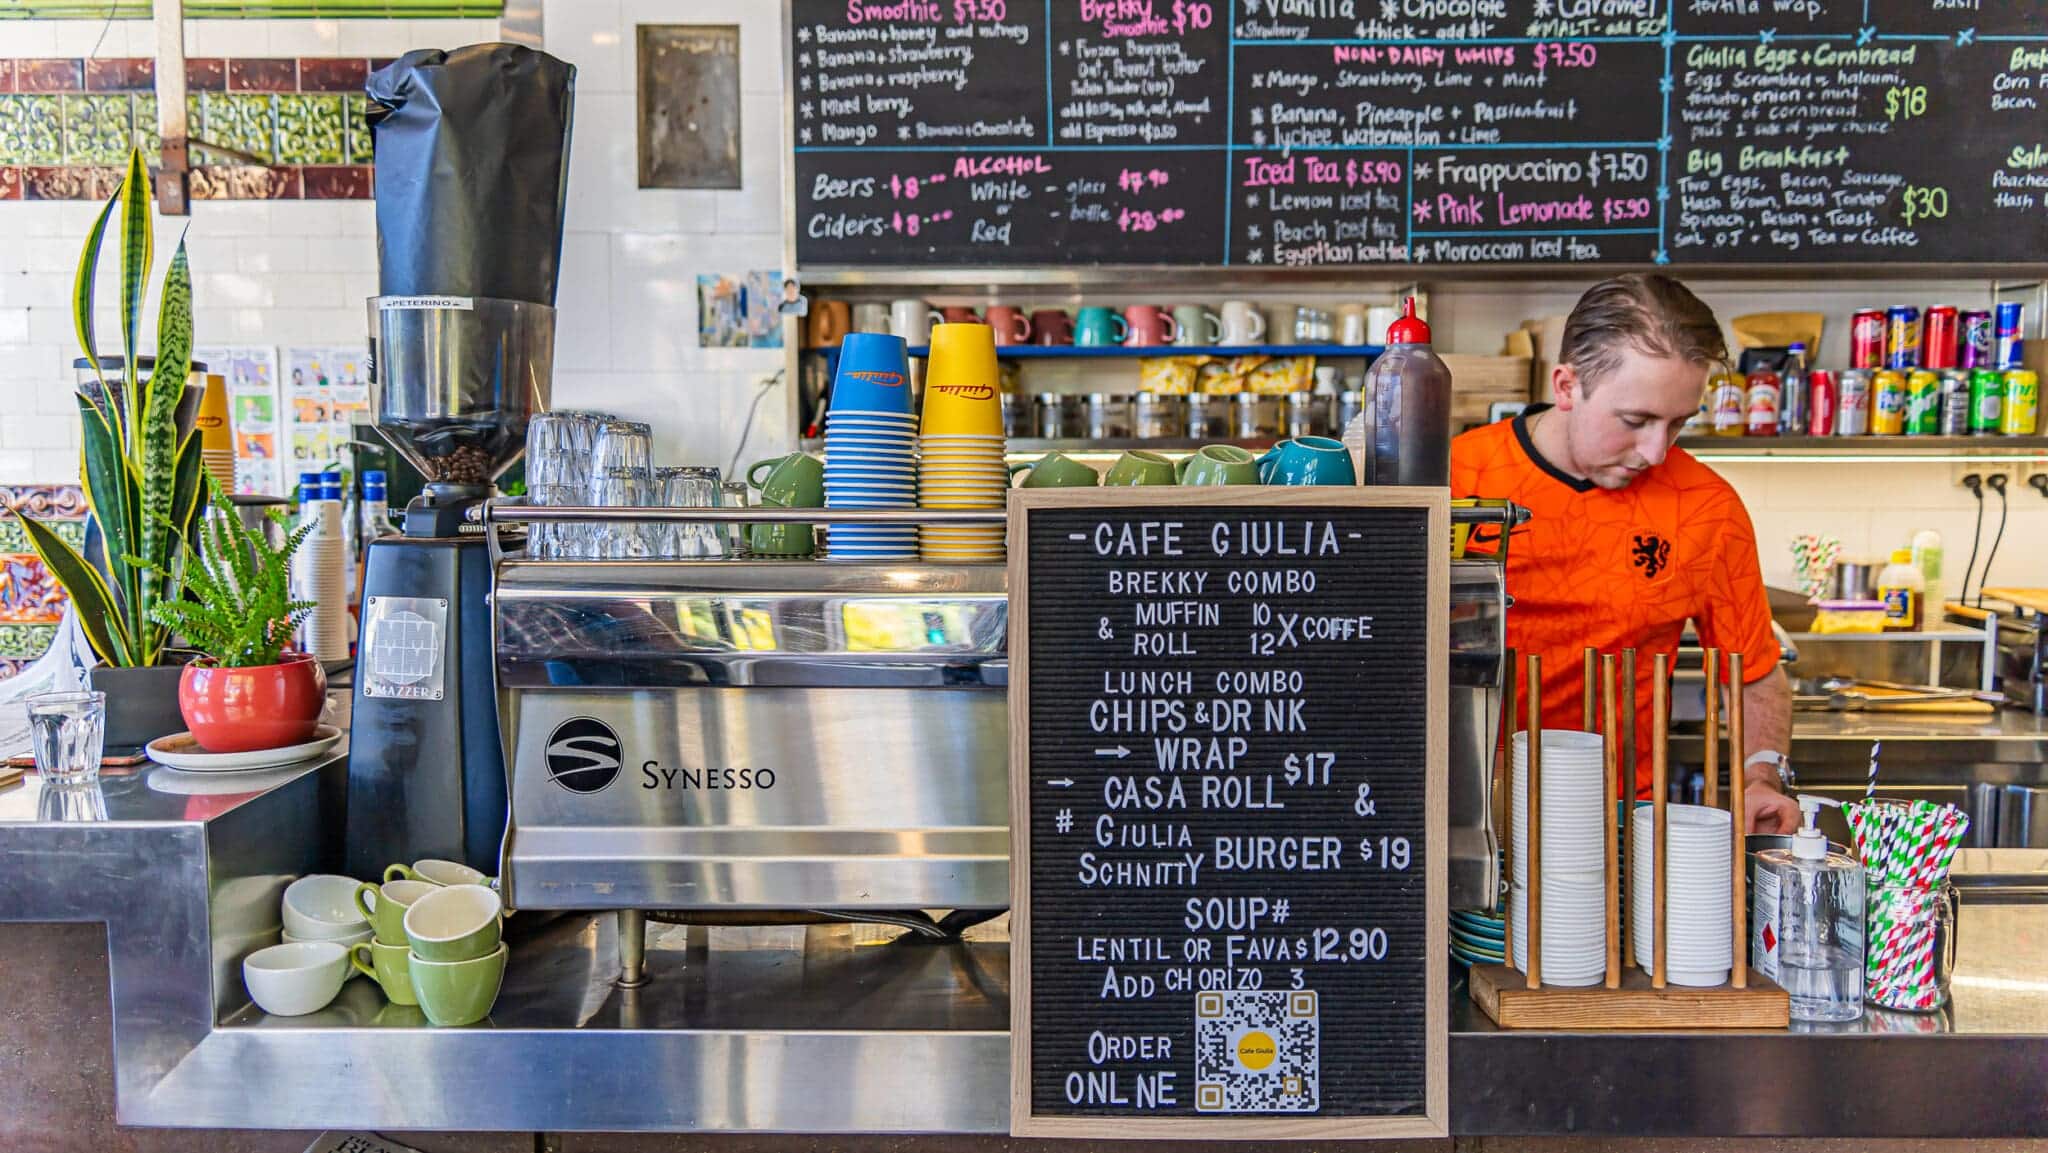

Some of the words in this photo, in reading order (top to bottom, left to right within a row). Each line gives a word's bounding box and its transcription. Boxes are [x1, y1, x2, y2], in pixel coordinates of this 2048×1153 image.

[847, 0, 942, 24] Smoothie
[1081, 0, 1152, 22] Brekky
[1172, 0, 1212, 36] $10
[946, 24, 973, 38] and
[1103, 15, 1168, 38] Smoothie
[1533, 43, 1596, 70] $7.50
[1686, 44, 1747, 69] Giulia
[1754, 44, 1797, 73] Eggs
[1993, 73, 2029, 91] Corn
[820, 95, 860, 116] Mixed
[1753, 88, 1800, 104] onion
[1884, 85, 1928, 122] $18
[1356, 101, 1444, 129] Pineapple
[821, 123, 877, 145] Mango
[954, 156, 1053, 178] ALCOHOL
[1243, 156, 1295, 186] Iced
[1303, 156, 1341, 184] Tea
[1438, 155, 1581, 192] Frappuccino
[1587, 150, 1648, 188] $7.50
[1687, 149, 1723, 176] Big
[1739, 145, 1850, 171] Breakfast
[812, 174, 875, 199] Beers
[970, 181, 1032, 202] White
[1066, 179, 1107, 199] glass
[1677, 176, 1710, 193] Two
[1269, 187, 1333, 211] Lemon
[1437, 193, 1484, 224] Pink
[1498, 192, 1594, 225] Lemonade
[1603, 197, 1649, 224] $5.90
[1901, 186, 1948, 226] $30
[1993, 192, 2033, 208] Hash
[971, 220, 1012, 246] Red
[1273, 217, 1326, 242] Peach
[1808, 229, 1837, 245] Tea
[1861, 227, 1919, 246] Coffee
[1273, 241, 1352, 266] Egyptian
[1435, 239, 1525, 261] Moroccan
[1567, 236, 1600, 260] tea
[931, 384, 994, 400] Giulia
[1109, 570, 1208, 594] BREKKY
[1228, 570, 1316, 594] COMBO
[1136, 602, 1219, 626] MUFFIN
[1252, 602, 1271, 626] 10
[1302, 616, 1373, 641] COFFE
[1134, 633, 1197, 655] ROLL
[1250, 633, 1275, 655] 12
[1104, 671, 1192, 695] LUNCH
[1216, 670, 1303, 694] COMBO
[1090, 700, 1186, 733] CHIPS
[1155, 737, 1248, 772] WRAP
[1284, 752, 1335, 786] $17
[1104, 775, 1186, 809] CASA
[1202, 775, 1284, 809] ROLL
[1215, 836, 1341, 870] BURGER
[1360, 836, 1410, 870] $19
[1078, 936, 1170, 961] LENTIL
[1184, 938, 1211, 962] OR
[1290, 968, 1305, 989] 3
